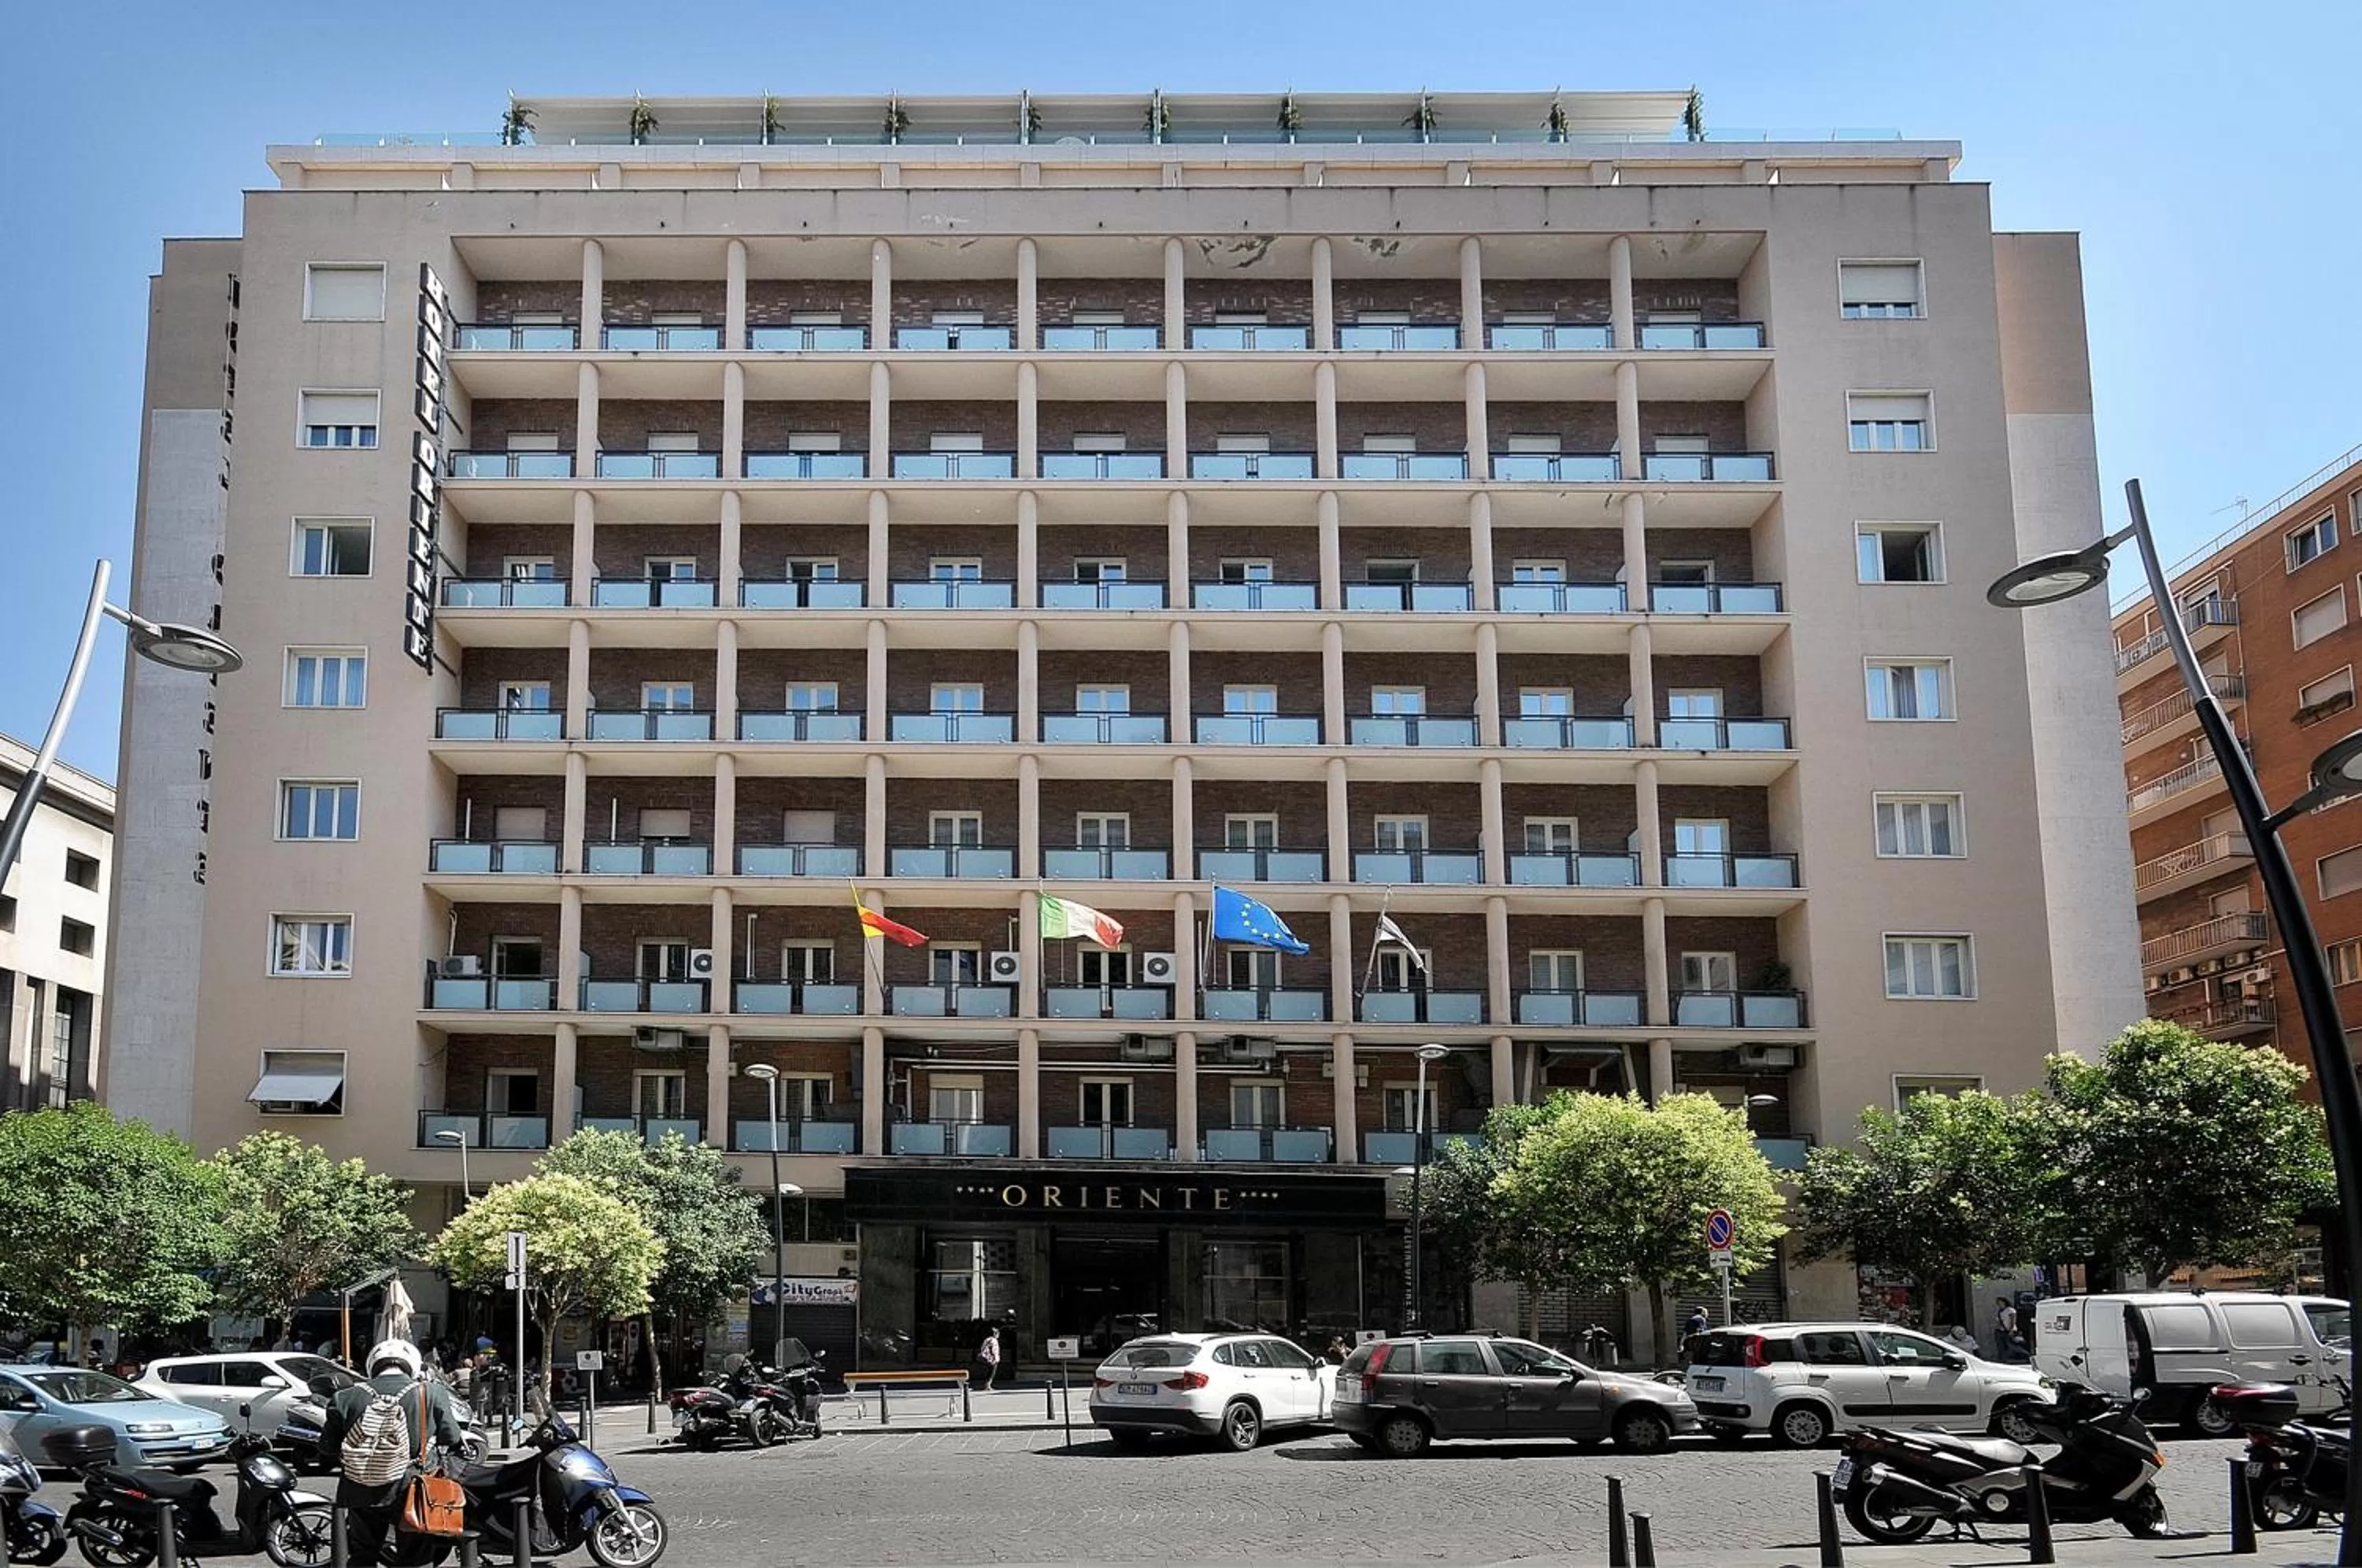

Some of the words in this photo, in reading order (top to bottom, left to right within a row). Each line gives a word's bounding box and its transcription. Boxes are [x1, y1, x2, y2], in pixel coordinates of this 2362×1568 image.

[417, 263, 444, 434] HOTEL
[405, 432, 438, 668] ORIENTE
[1001, 1184, 1231, 1211] ORIENTE
